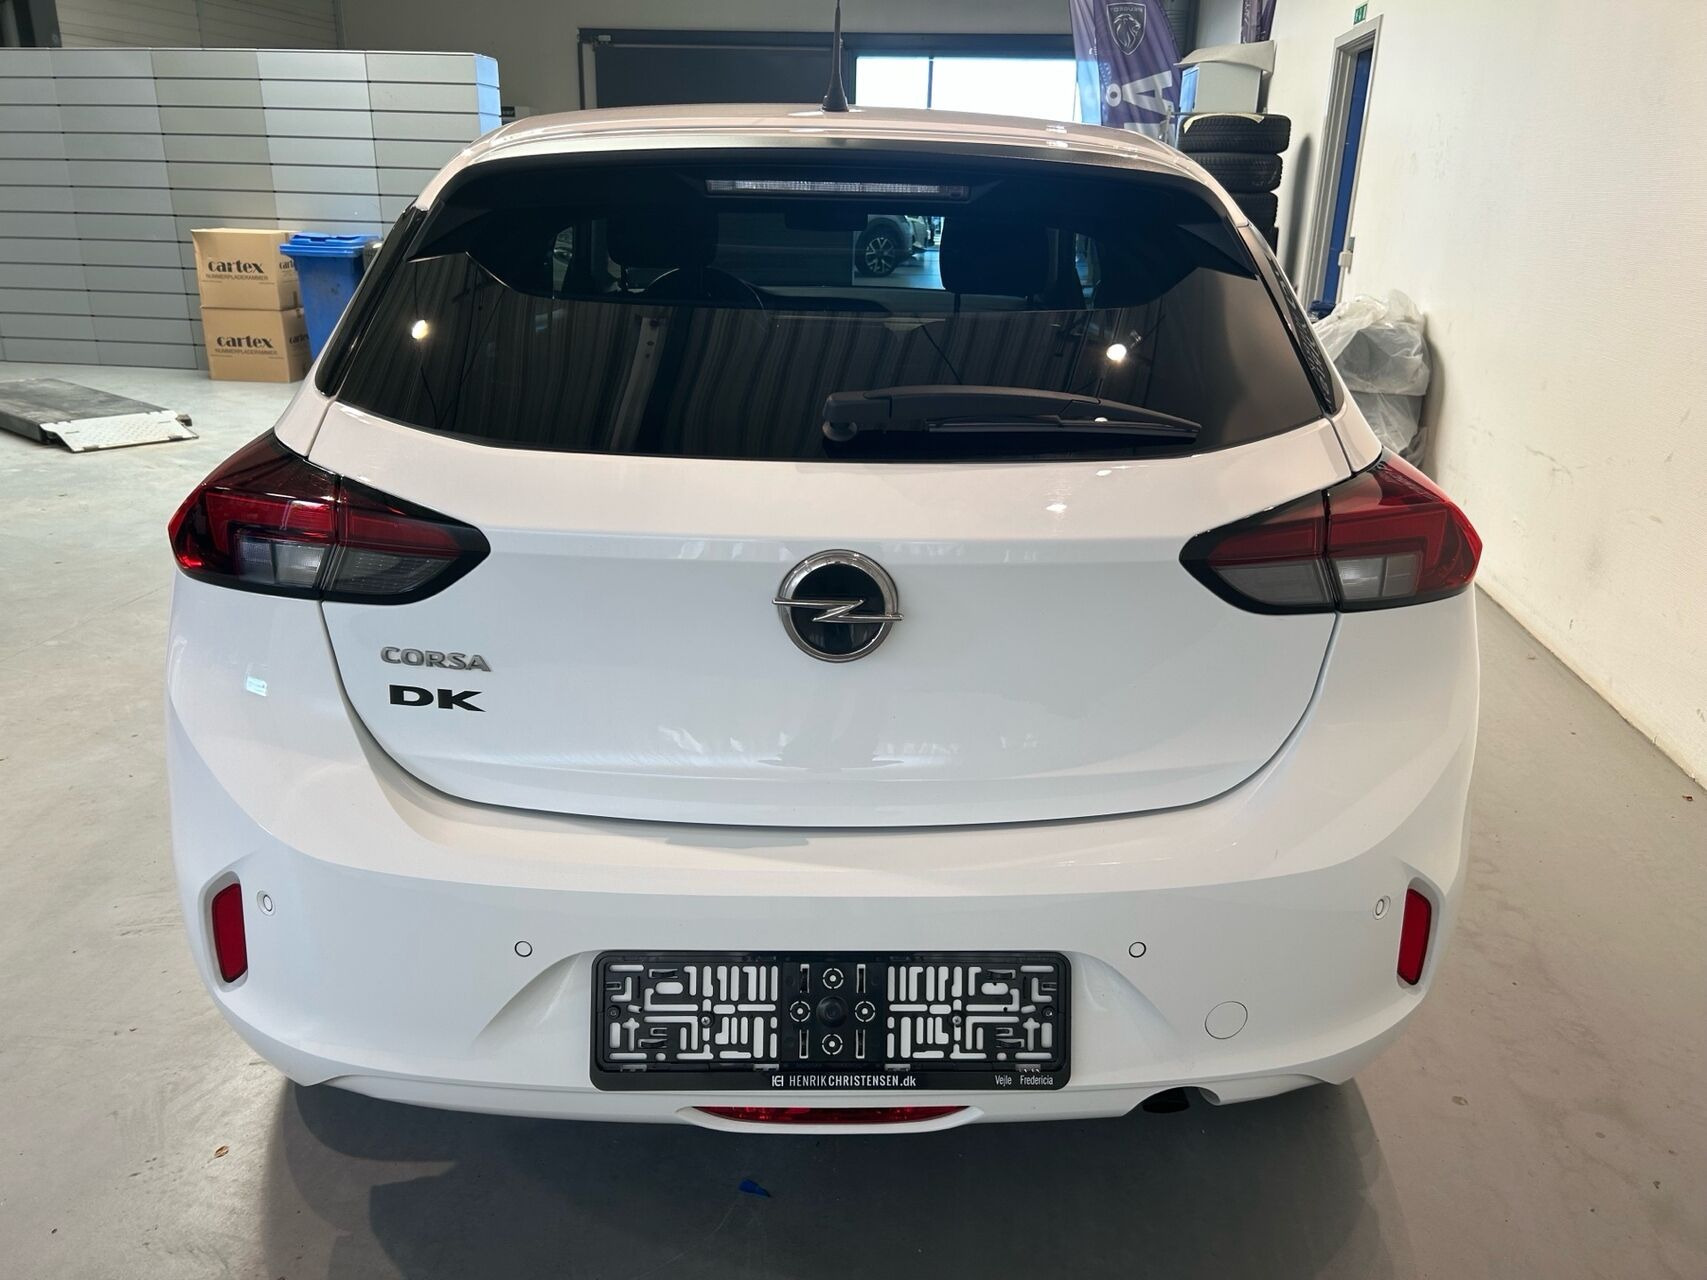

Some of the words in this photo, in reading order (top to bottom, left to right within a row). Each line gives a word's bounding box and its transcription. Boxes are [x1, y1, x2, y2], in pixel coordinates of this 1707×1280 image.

[207, 260, 265, 274] cartex
[216, 335, 274, 349] cartex
[381, 646, 492, 672] CORSA
[389, 684, 487, 712] DK
[995, 1075, 1012, 1087] Vejle
[1020, 1075, 1053, 1085] Fredericia
